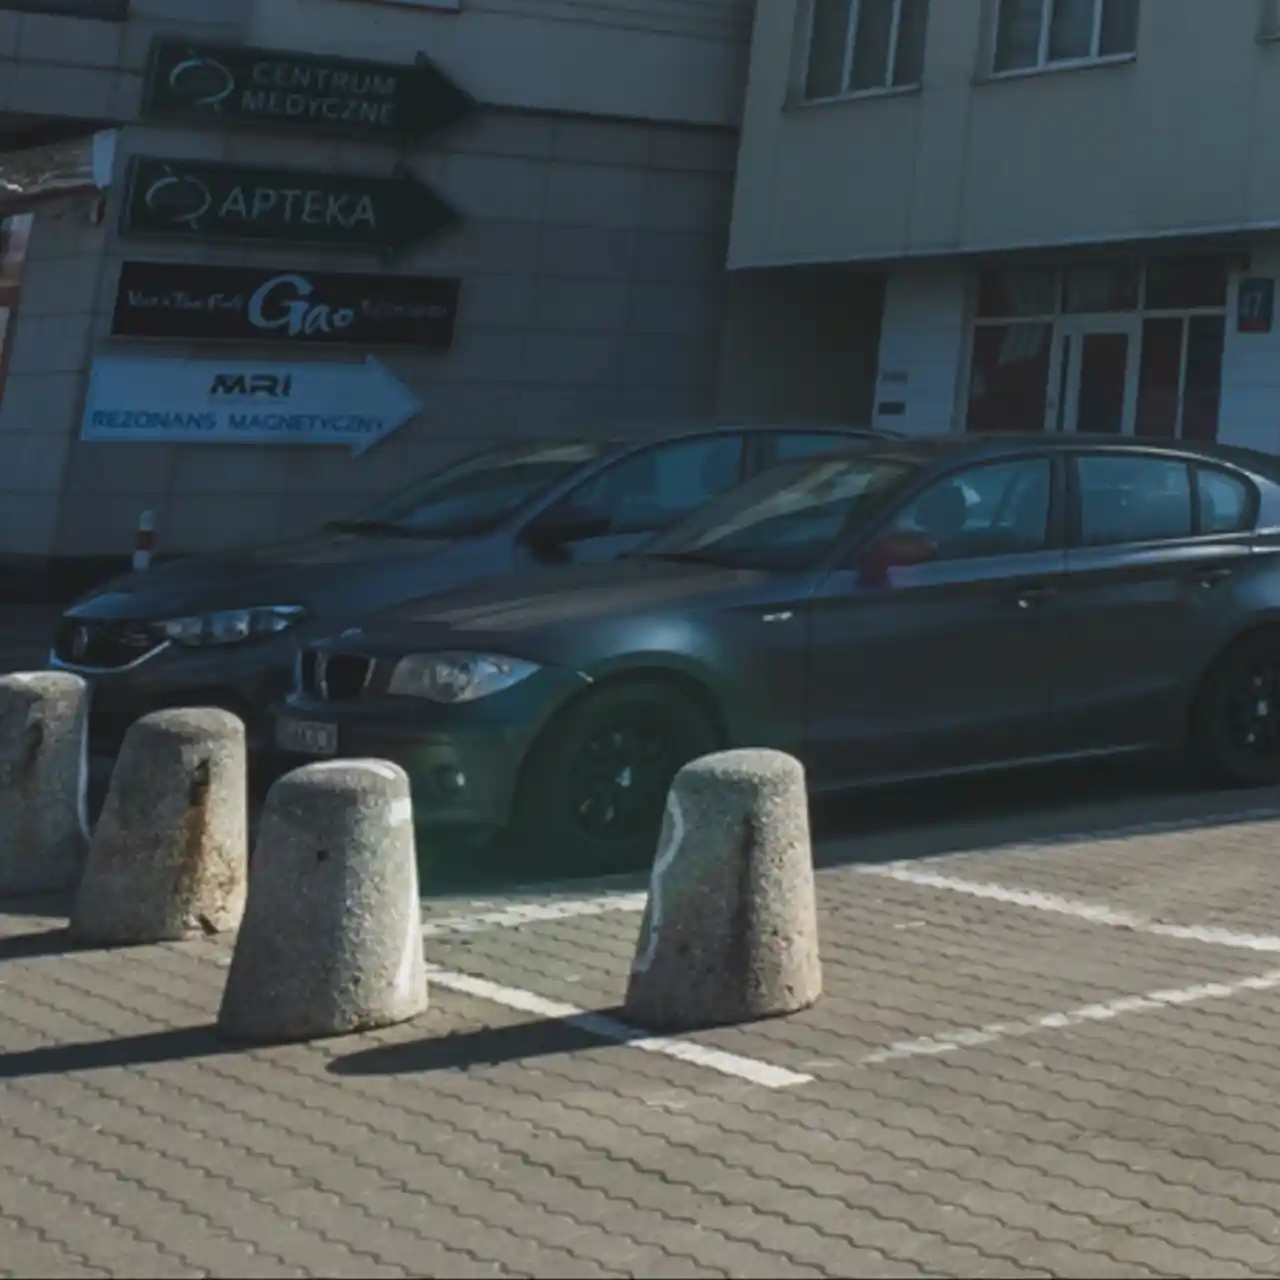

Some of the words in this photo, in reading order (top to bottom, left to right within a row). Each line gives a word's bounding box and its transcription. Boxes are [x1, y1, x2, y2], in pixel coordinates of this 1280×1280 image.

[253, 62, 397, 95] CENTRUM
[242, 90, 397, 125] MEDYCZNE
[219, 187, 377, 227] APTEKA
[248, 273, 355, 337] Gao
[210, 373, 292, 397] MRI
[92, 410, 217, 430] REZONANS
[229, 413, 387, 434] MAGNETYCZNY
